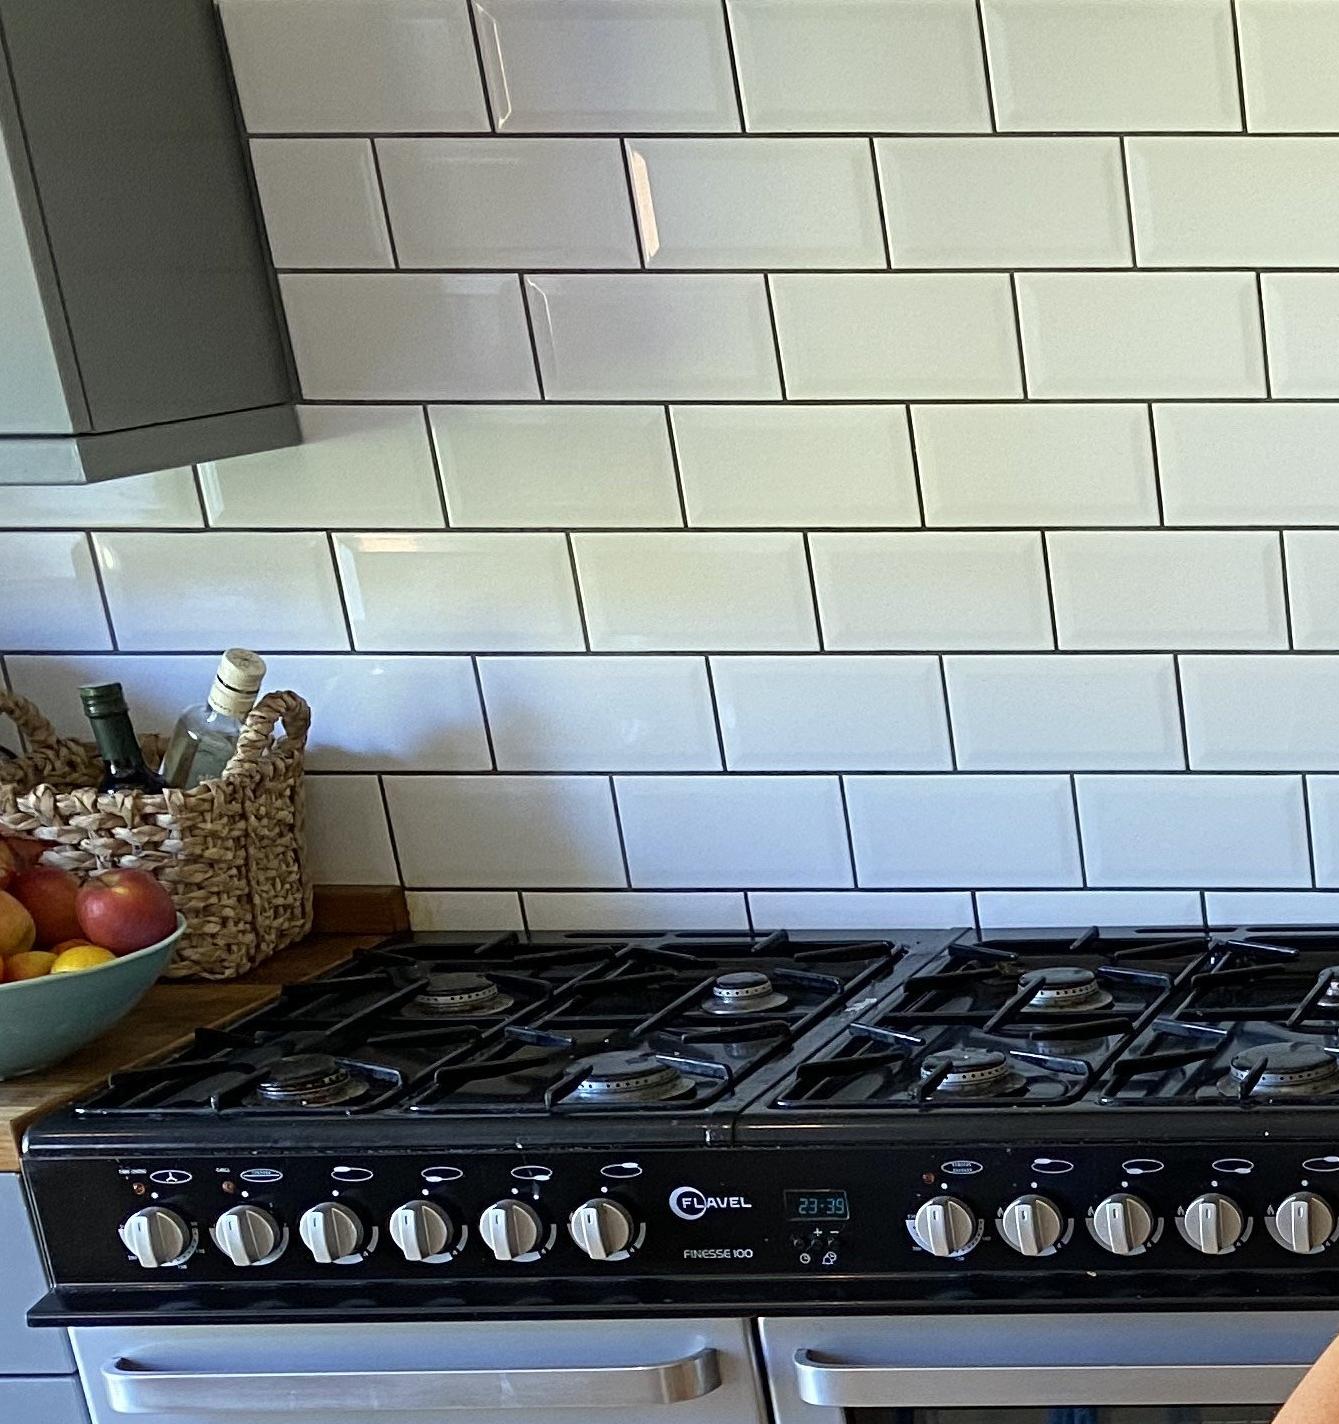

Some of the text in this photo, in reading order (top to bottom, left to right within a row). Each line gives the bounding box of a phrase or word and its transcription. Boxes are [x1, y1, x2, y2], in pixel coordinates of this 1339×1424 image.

[682, 1196, 753, 1209] FLAVEL
[683, 1249, 754, 1259] FINESSE 100
